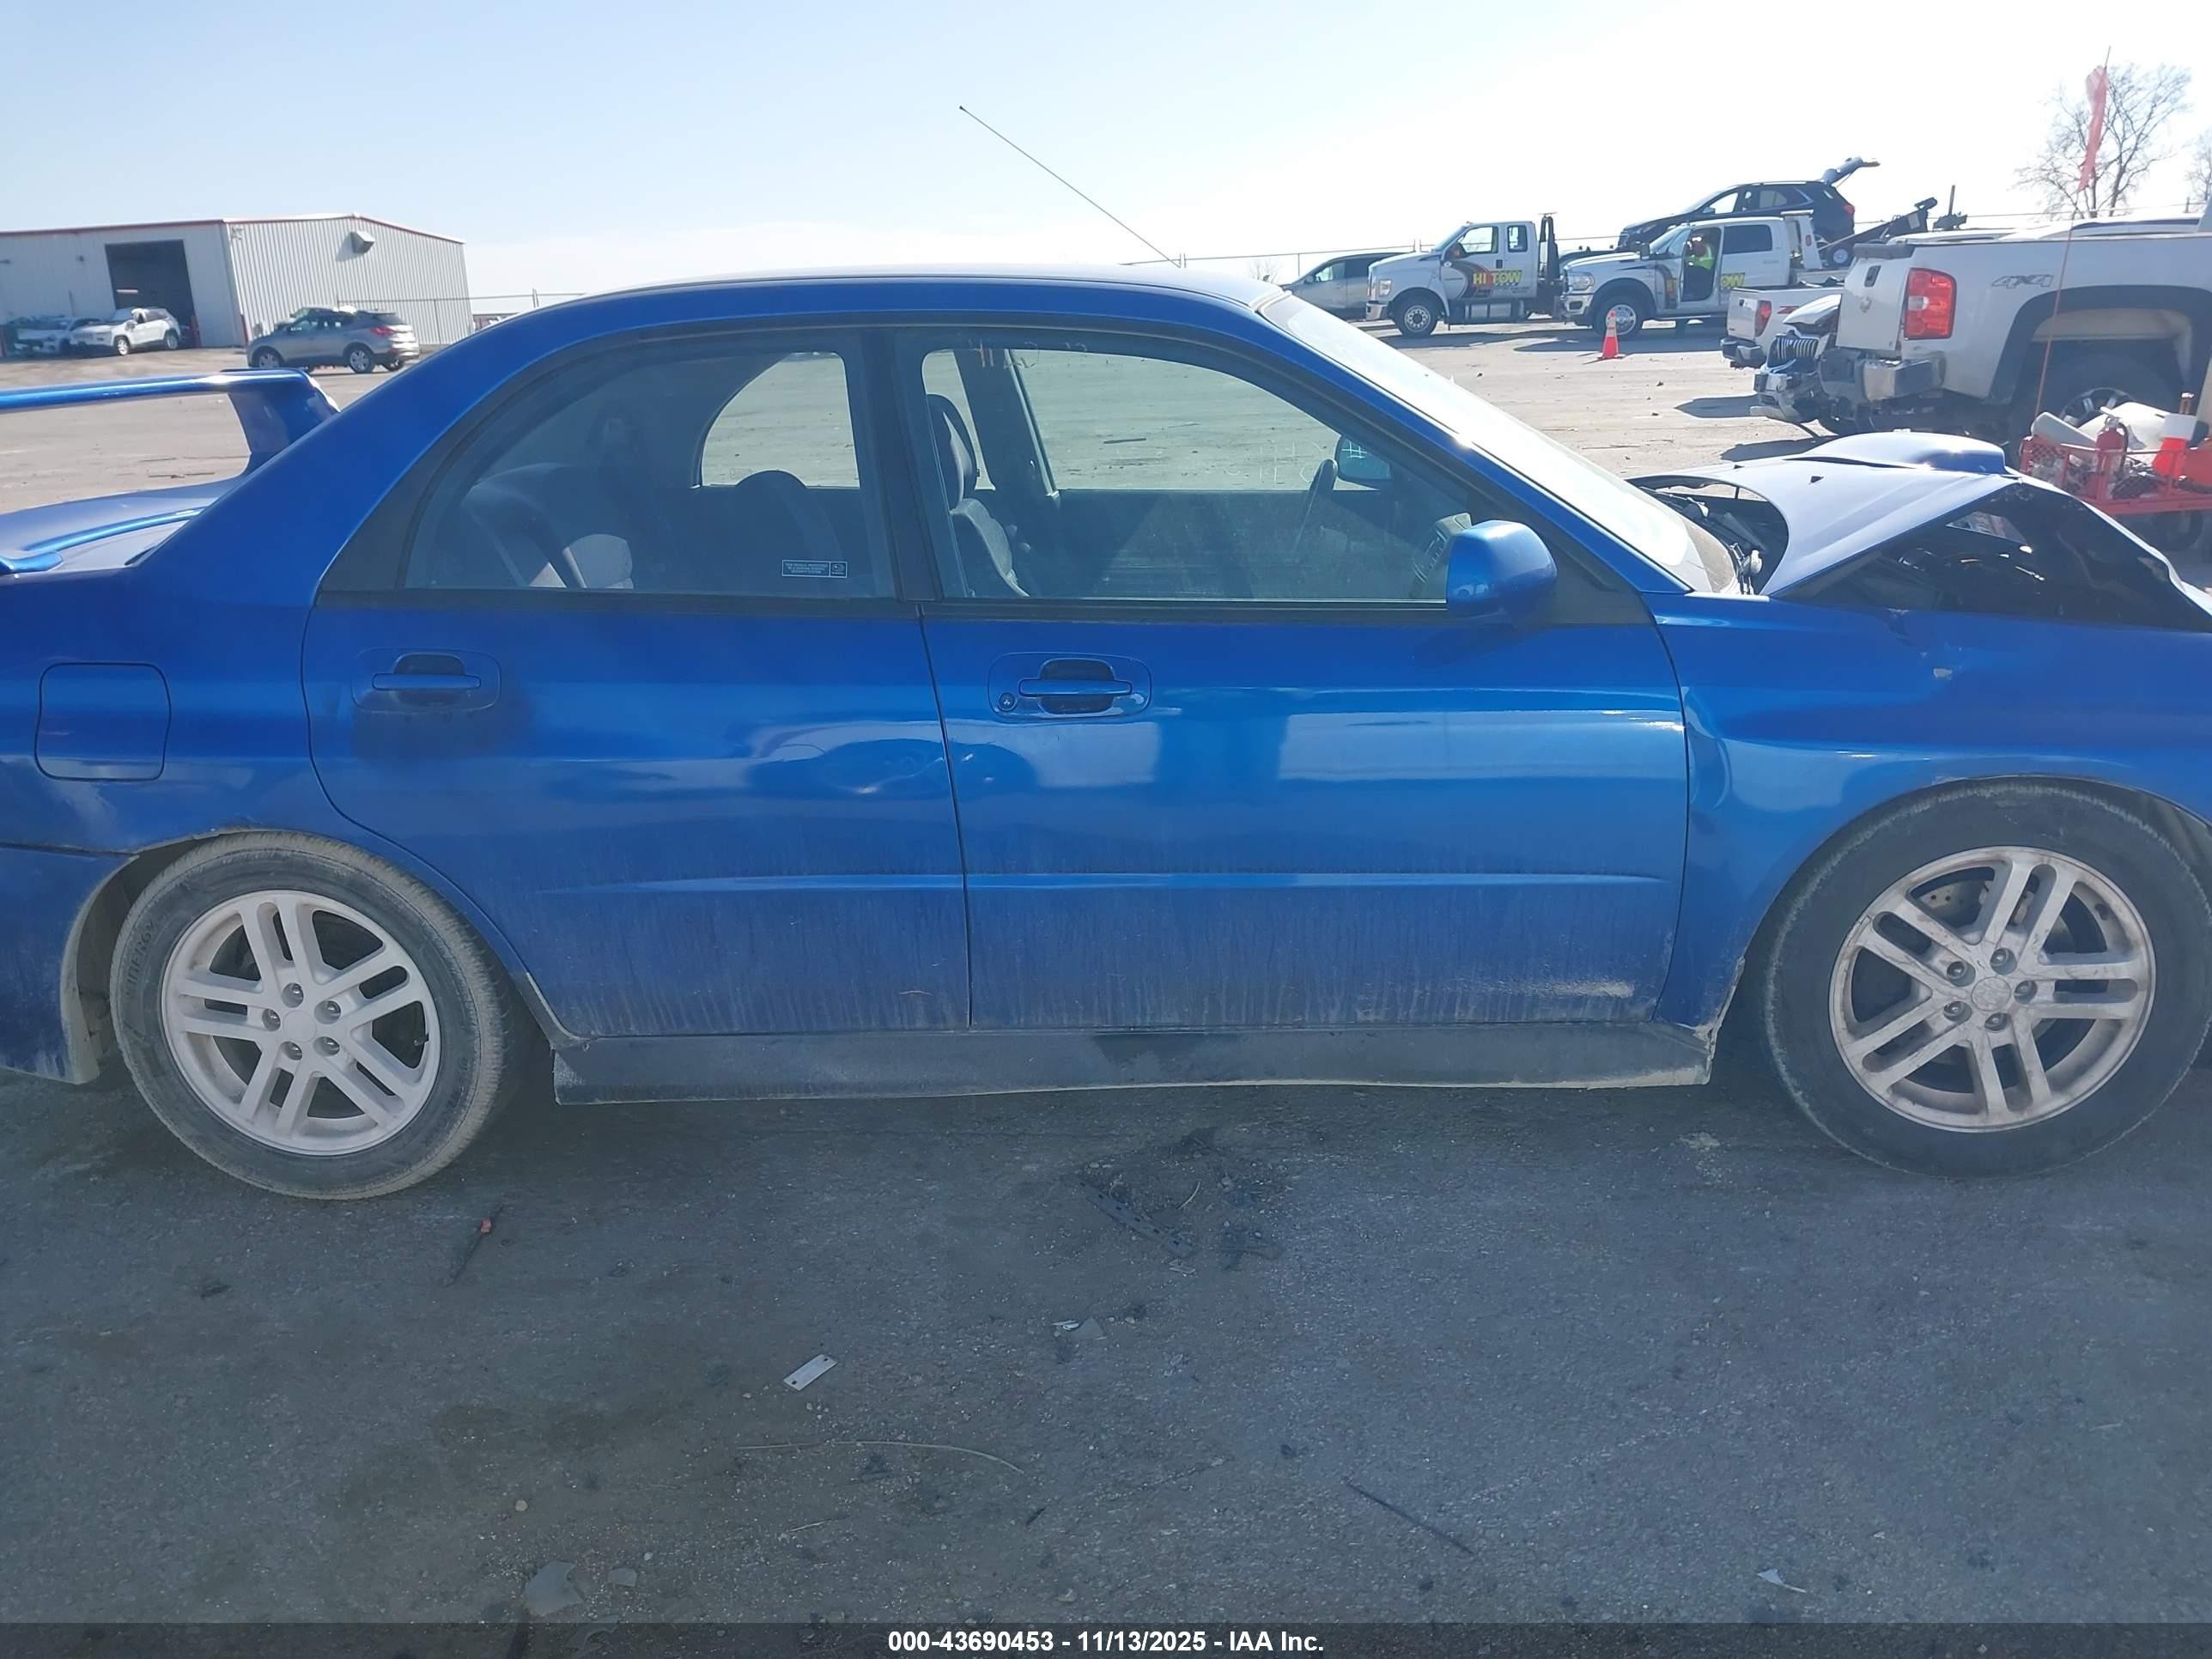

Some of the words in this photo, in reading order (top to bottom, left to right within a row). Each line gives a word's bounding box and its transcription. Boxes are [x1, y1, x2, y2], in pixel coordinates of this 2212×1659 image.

[1473, 272, 1486, 284] HI
[1491, 270, 1522, 284] TOW
[1720, 273, 1745, 288] OW
